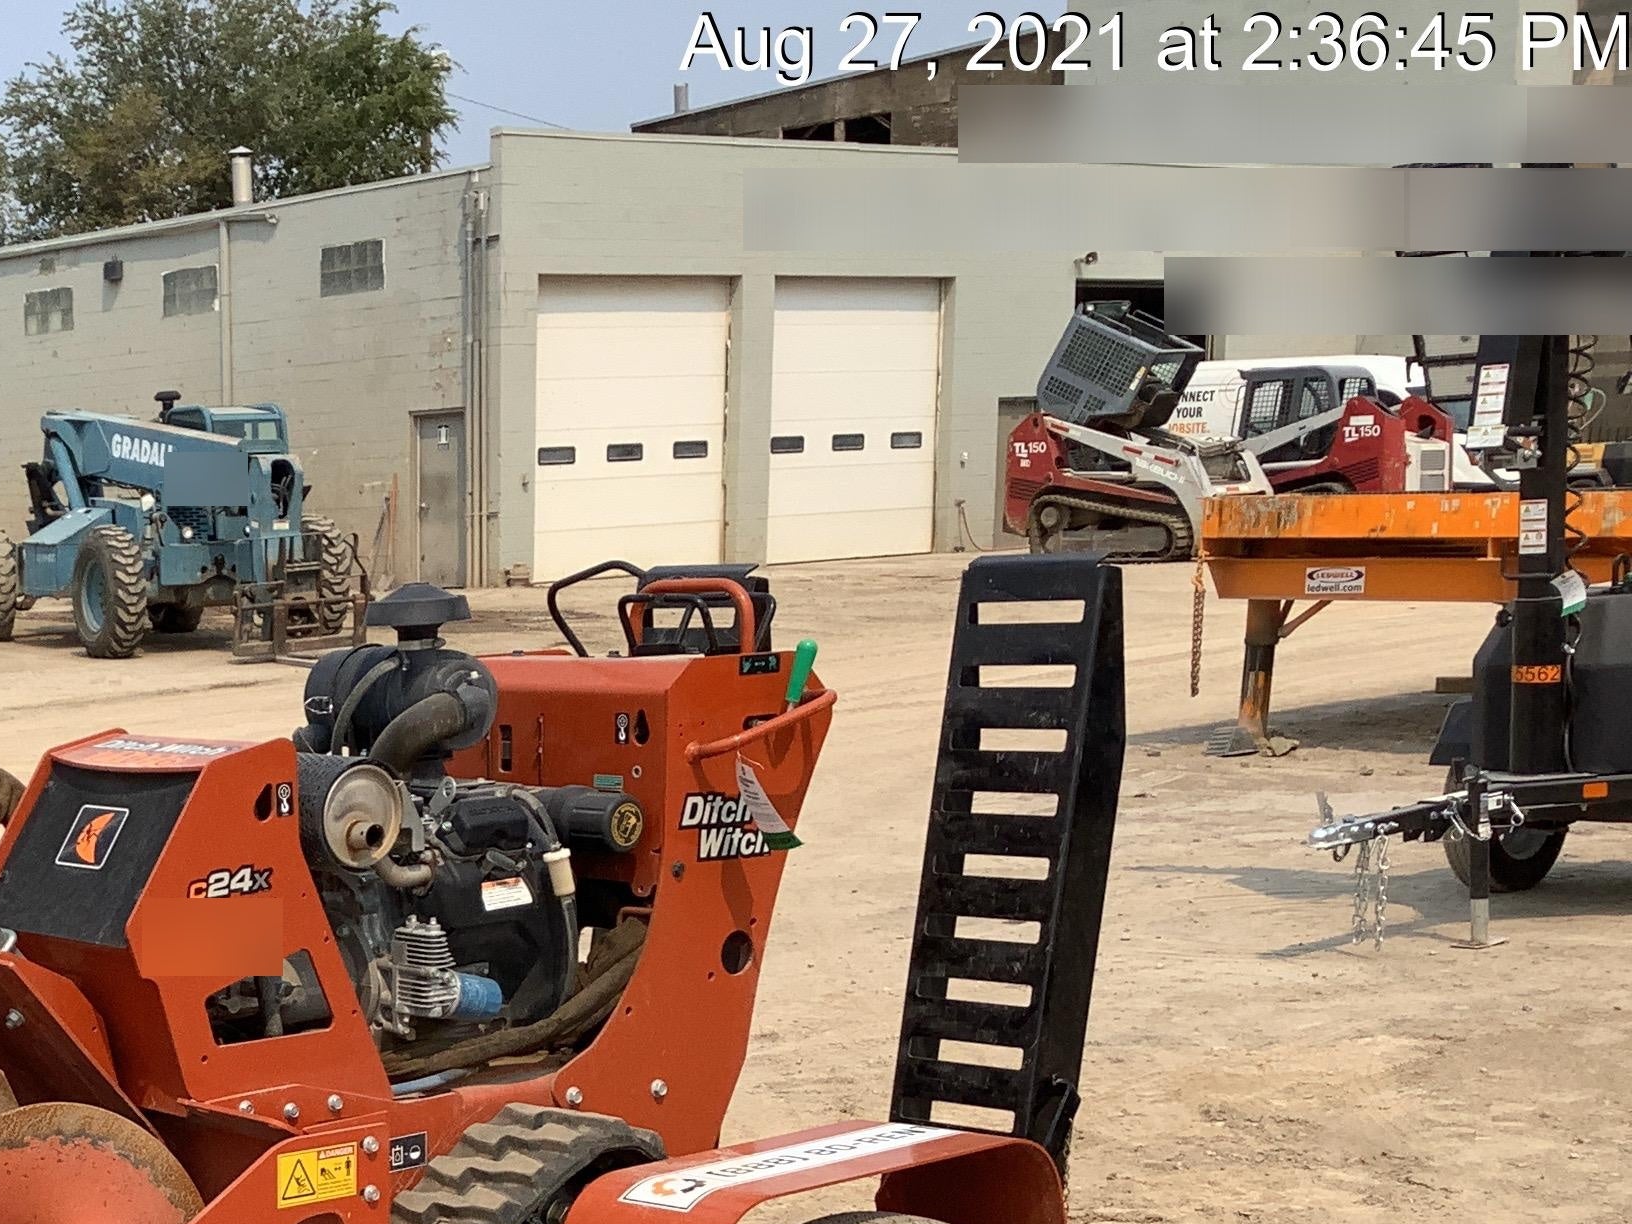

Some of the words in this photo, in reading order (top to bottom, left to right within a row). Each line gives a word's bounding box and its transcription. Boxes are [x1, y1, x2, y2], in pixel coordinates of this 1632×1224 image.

[1176, 406, 1203, 418] YOUR
[1342, 424, 1381, 443] TL150
[1307, 583, 1362, 592] ledwell.com
